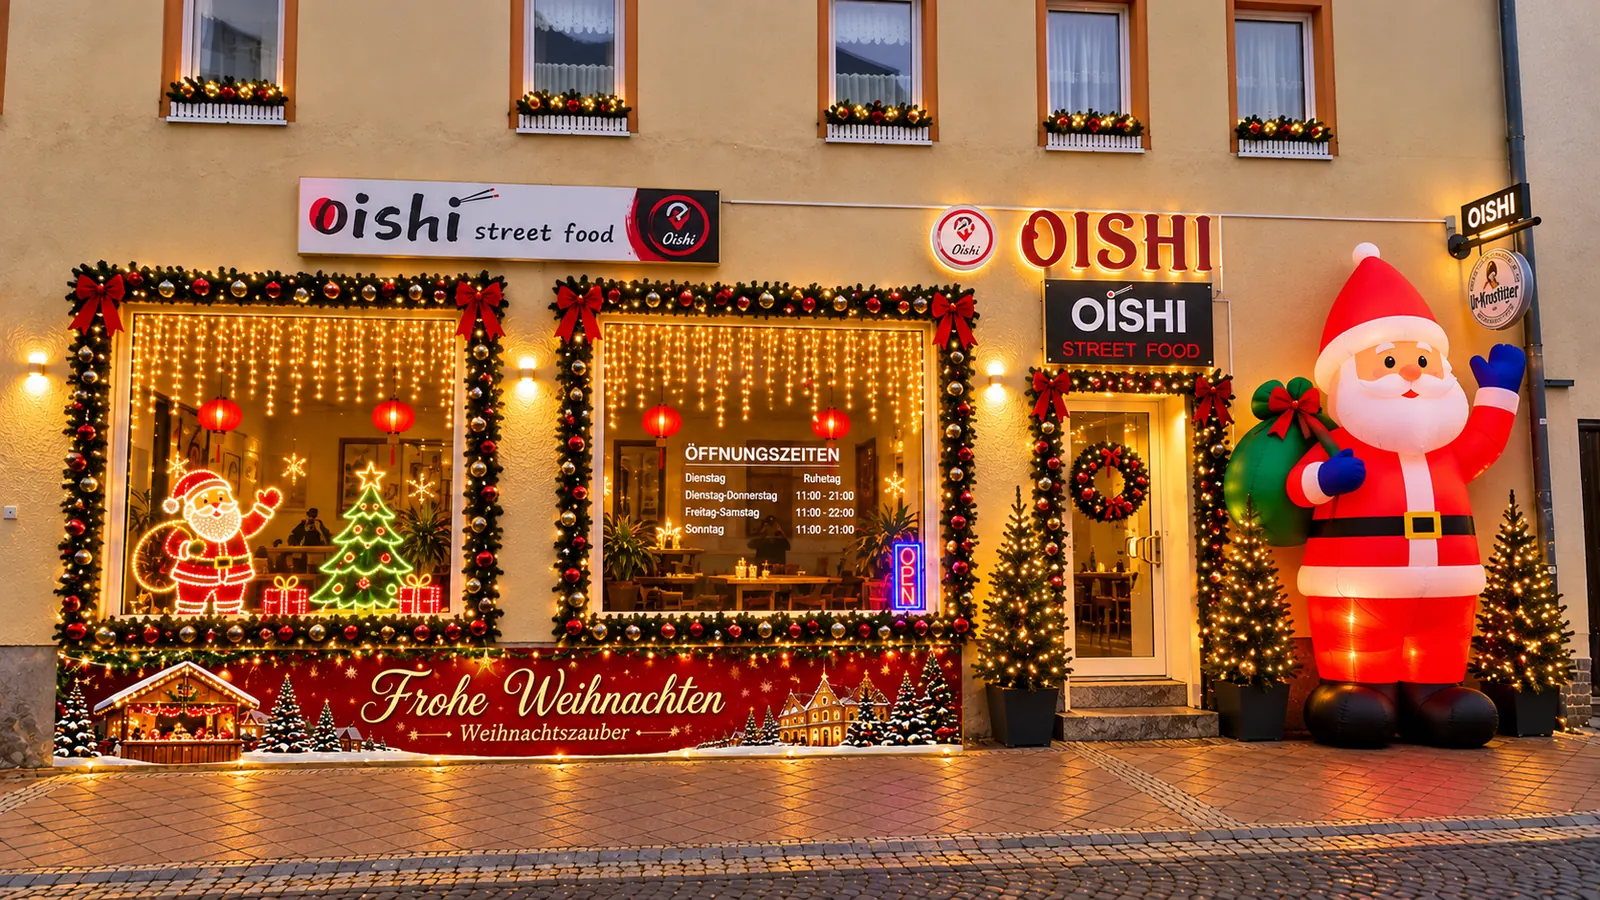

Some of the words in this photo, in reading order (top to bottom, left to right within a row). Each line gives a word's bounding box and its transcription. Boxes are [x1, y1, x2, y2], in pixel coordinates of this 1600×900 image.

[310, 192, 460, 243] oishi
[475, 222, 552, 242] street
[564, 221, 614, 244] food
[1467, 191, 1516, 229] OISHI
[662, 231, 697, 246] Oishi
[1020, 208, 1213, 272] OISHI
[951, 243, 981, 257] Oishi
[1062, 340, 1137, 358] STREET
[1146, 342, 1200, 359] FOOD
[685, 442, 840, 463] ÖFFNUNGSZEITEN
[685, 472, 726, 485] Dienstag
[803, 473, 841, 486] Ruhetag
[685, 489, 778, 502] Dienstag-Donnerstag
[795, 490, 821, 501] 11:00
[828, 490, 855, 501] 21:00
[685, 506, 760, 519] Freitag-Samstag
[795, 507, 821, 518] 11:00
[828, 507, 855, 518] 22:00
[685, 523, 725, 536] Sonntag
[795, 524, 822, 535] 11:00
[828, 524, 855, 535] 21:00
[899, 546, 917, 606] OPEN
[360, 668, 489, 724] Frohe
[502, 667, 727, 718] Weihnachten
[460, 722, 631, 743] Weihnachtszauber
